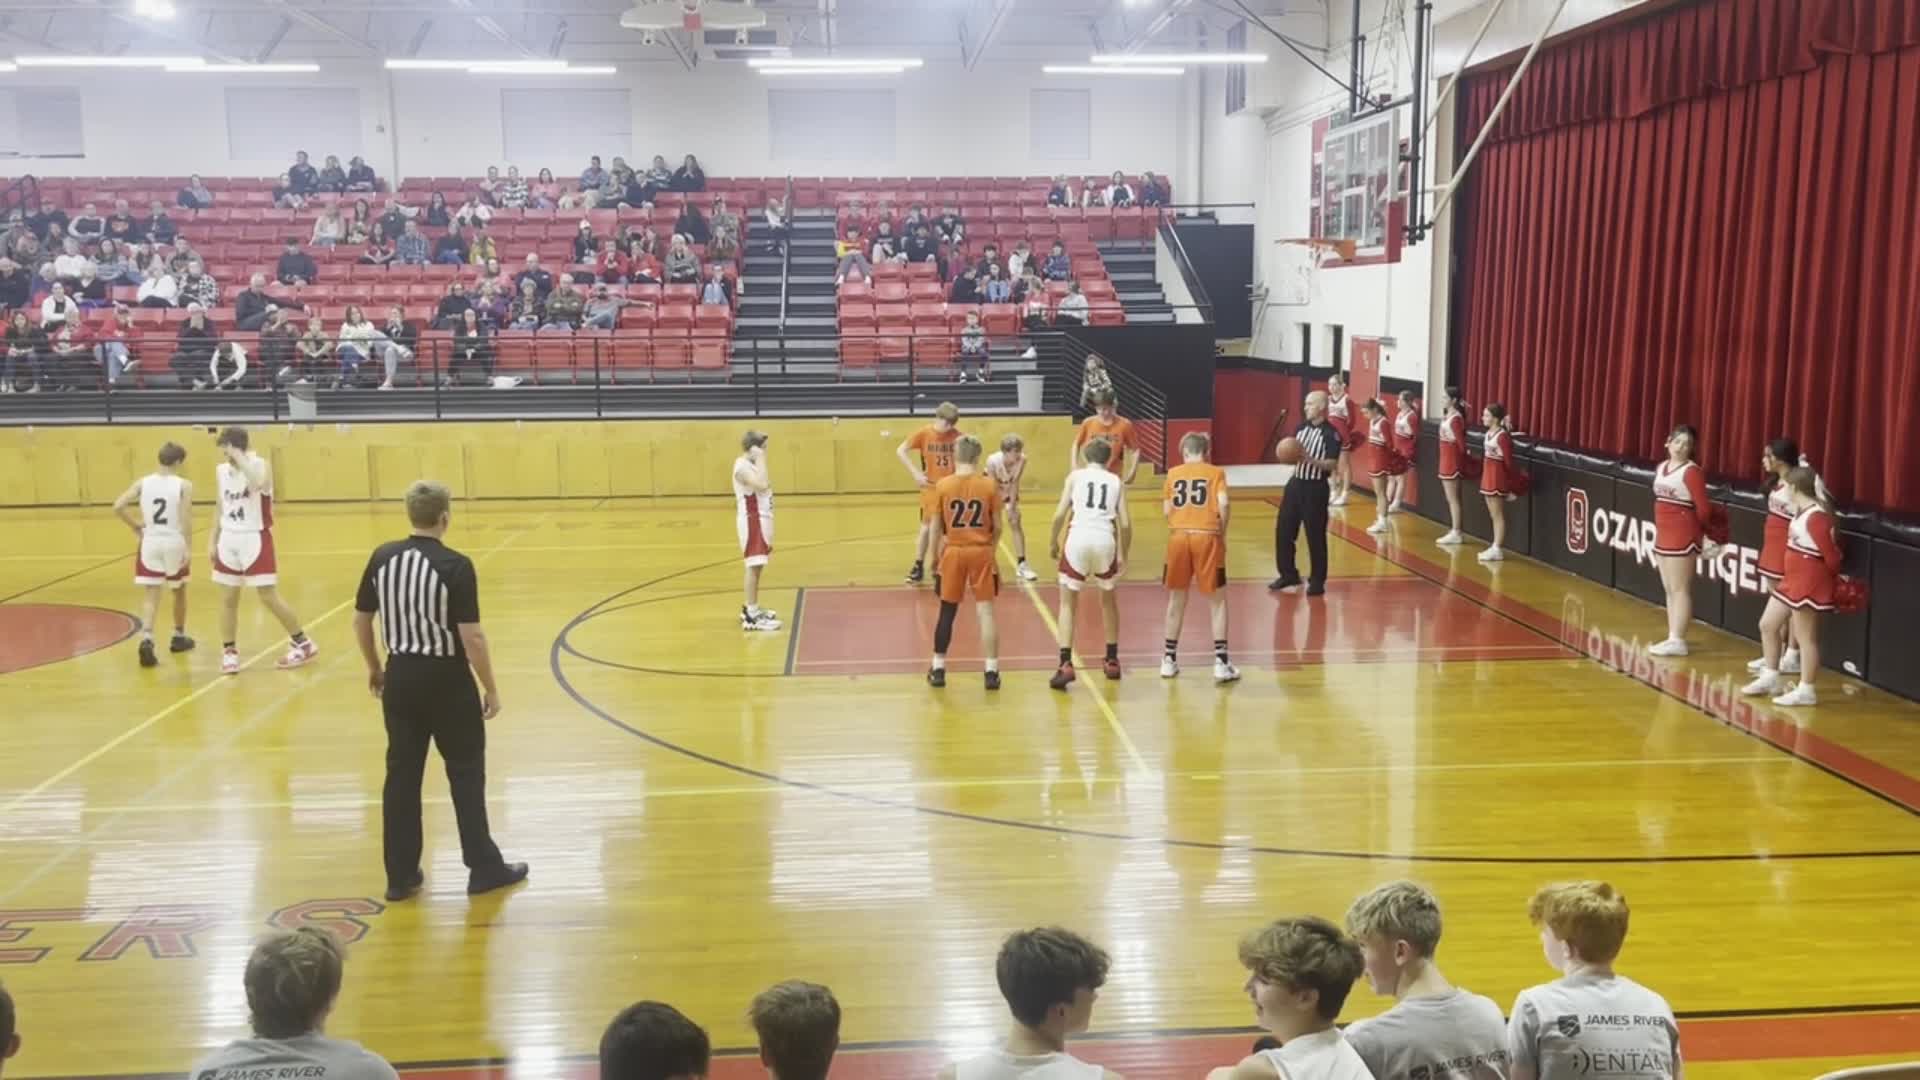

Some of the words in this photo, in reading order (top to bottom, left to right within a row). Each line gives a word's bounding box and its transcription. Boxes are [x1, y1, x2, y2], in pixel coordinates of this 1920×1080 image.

[1085, 481, 1109, 511] 11
[1172, 478, 1208, 508] 35
[152, 497, 168, 525] 2
[949, 498, 984, 529] 22
[1592, 507, 1657, 569] OZAR
[1583, 1014, 1630, 1026] JAMES
[1633, 1015, 1667, 1027] RIVER
[279, 1065, 326, 1079] RIVER
